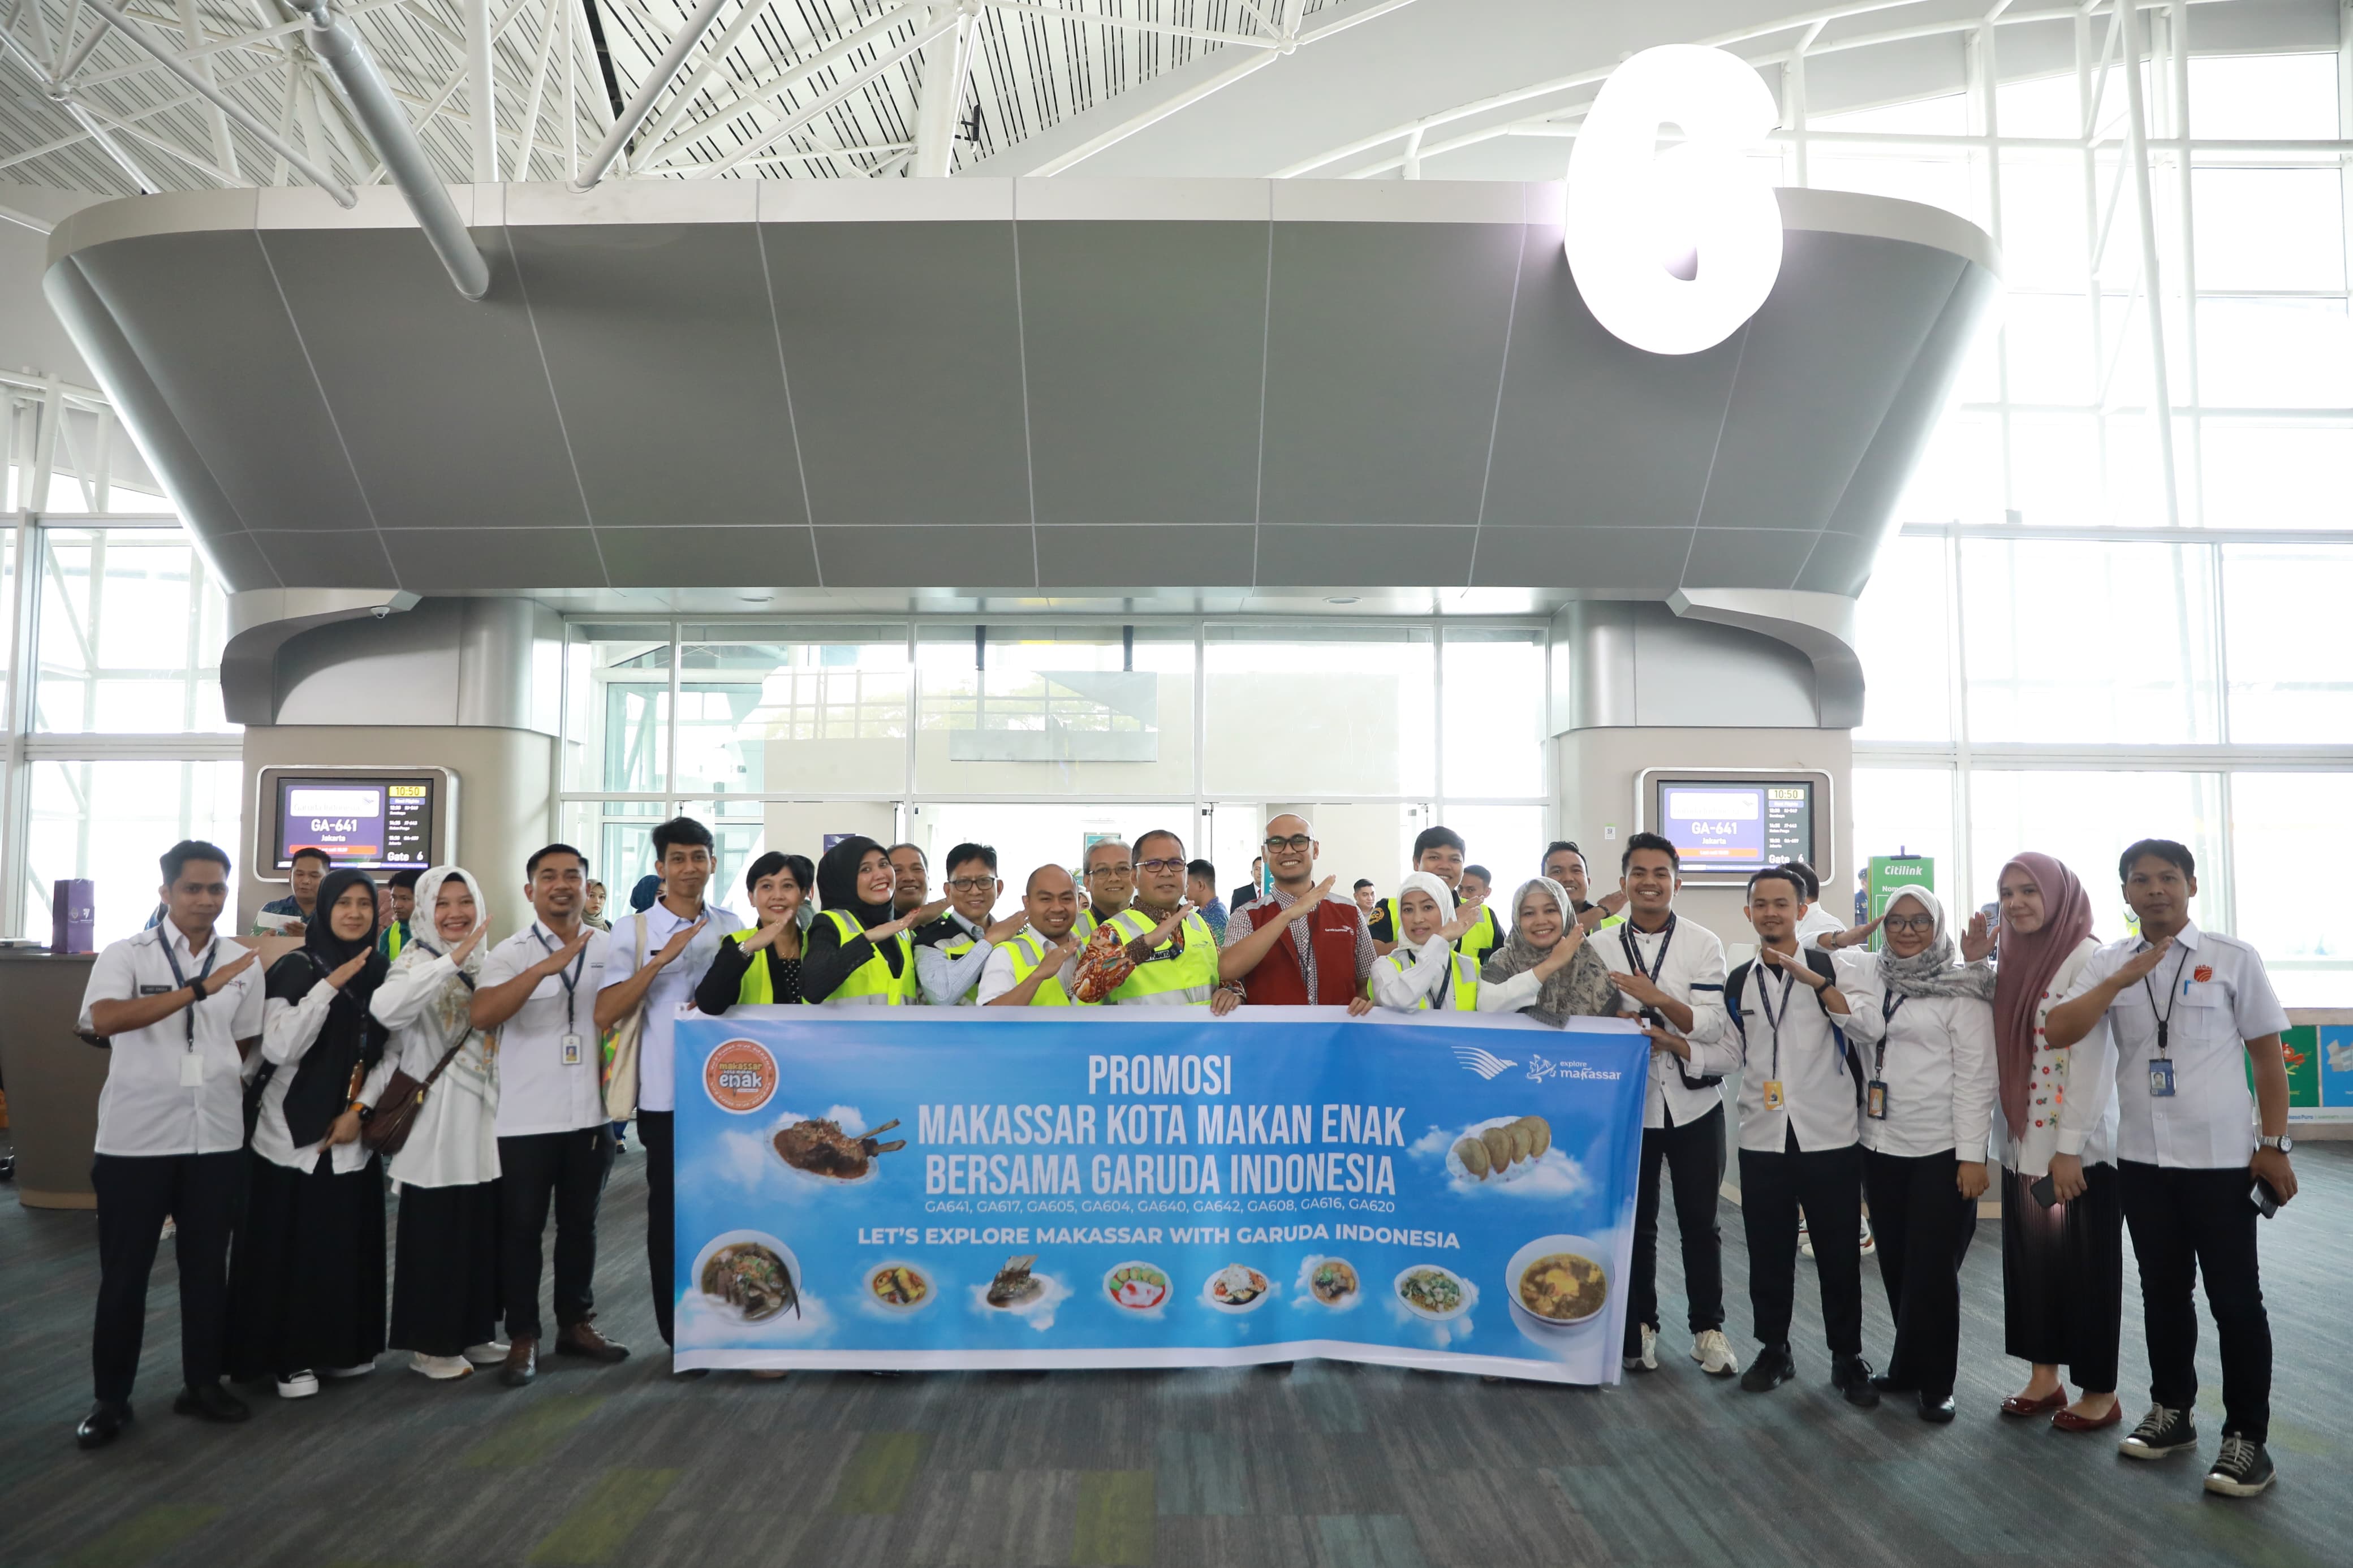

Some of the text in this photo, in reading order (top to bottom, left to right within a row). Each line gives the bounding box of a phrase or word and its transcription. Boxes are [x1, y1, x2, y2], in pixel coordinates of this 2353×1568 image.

[1565, 43, 1783, 355] 6
[396, 787, 419, 796] 10:50
[1774, 790, 1798, 798] 10:50
[311, 819, 357, 832] GA-641
[1691, 822, 1738, 835] GA-641
[387, 851, 424, 861] Gate 6
[1769, 854, 1804, 864] Gate 6
[1885, 866, 1923, 875] Citilink
[719, 1061, 762, 1070] makassar
[719, 1072, 762, 1088] enak
[1088, 1055, 1231, 1095] PROMOSI
[918, 1104, 1406, 1147] MAKASSAR KOTA MAKAN ENAK
[926, 1152, 1395, 1195] BERSAMA GARUDA INDONESIA
[925, 1197, 1395, 1214] GA641, GA617, GA605, GA604, GA640, GA642, GA608, GA616, GA620
[925, 1227, 1029, 1245] EXPLORE
[1036, 1227, 1163, 1245] MAKASSAR
[1169, 1226, 1230, 1245] WITH
[1236, 1223, 1329, 1244] GARUDA
[1335, 1224, 1460, 1249] INDONESIA
